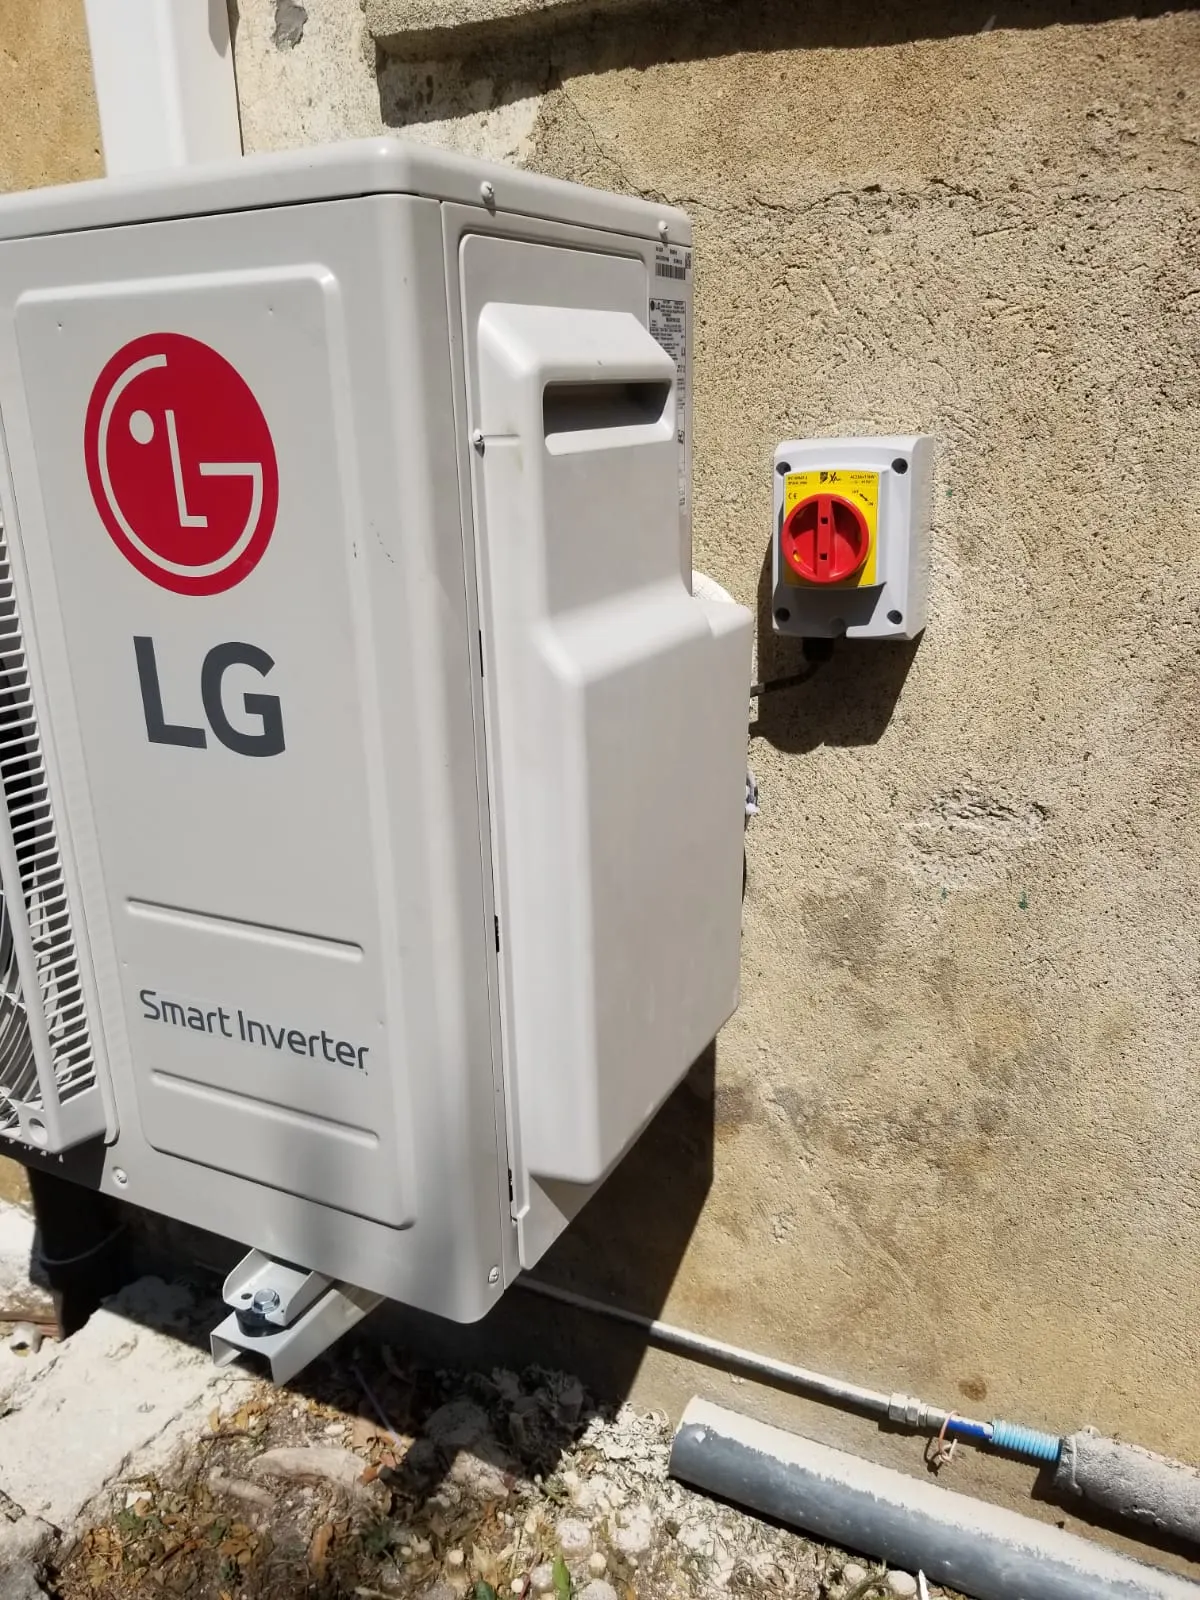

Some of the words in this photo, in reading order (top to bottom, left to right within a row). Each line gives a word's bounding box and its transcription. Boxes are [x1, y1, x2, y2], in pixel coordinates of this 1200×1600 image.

[97, 352, 265, 578] LG
[132, 634, 286, 757] LG
[139, 988, 233, 1039] Smart
[237, 1009, 370, 1070] Inverter
